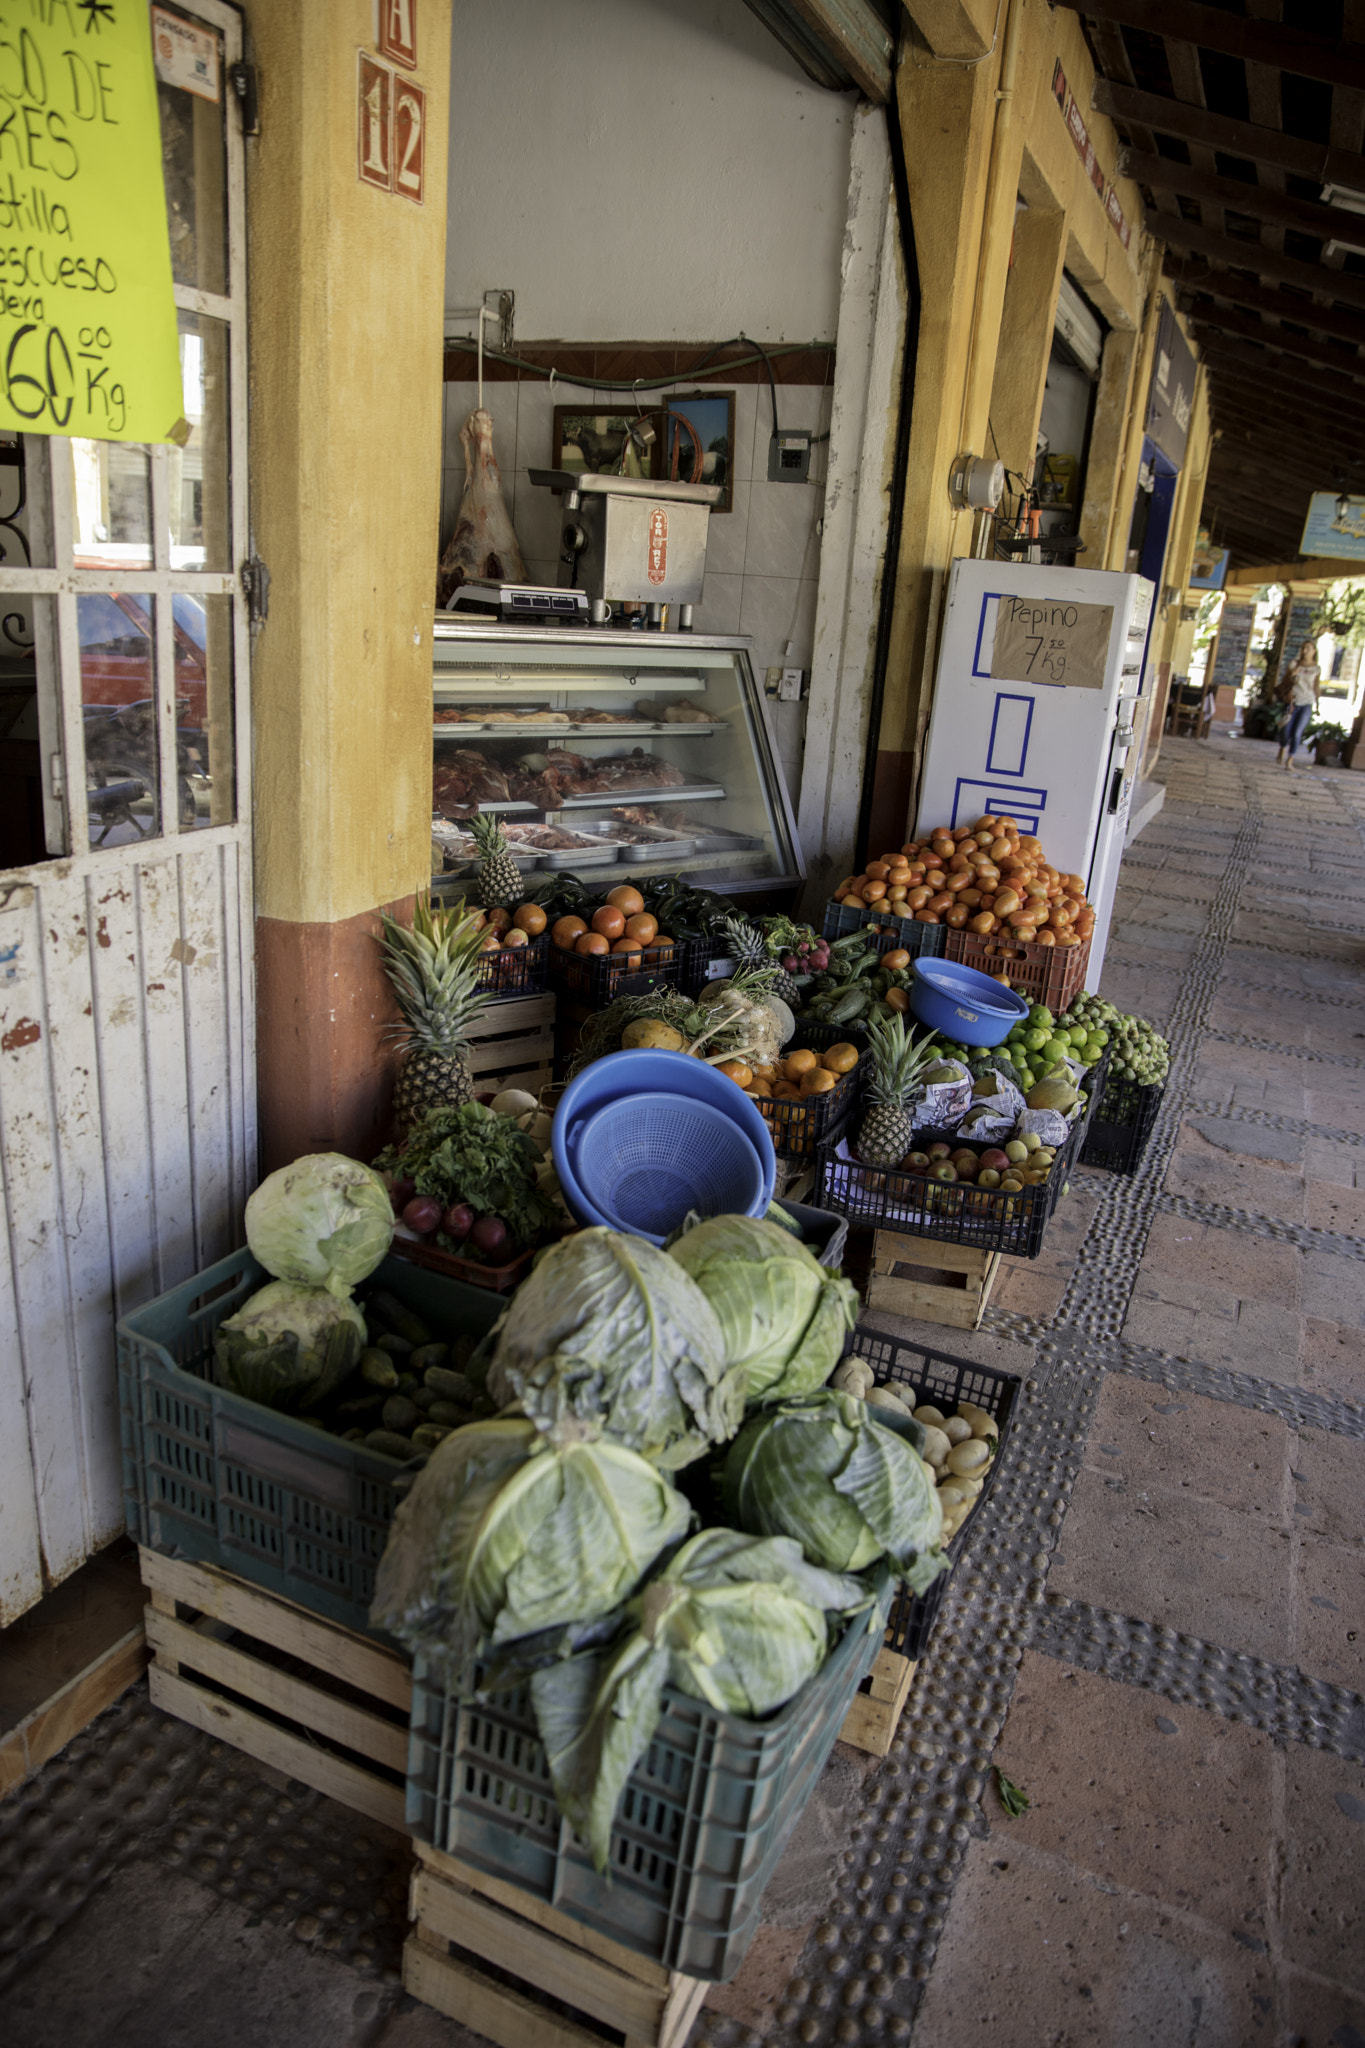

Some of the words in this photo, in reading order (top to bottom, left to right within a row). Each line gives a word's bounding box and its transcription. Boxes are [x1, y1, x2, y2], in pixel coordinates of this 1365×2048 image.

[62, 50, 119, 125] DE
[363, 75, 421, 190] 12
[652, 549, 661, 570] REY
[1007, 597, 1078, 635] Pepino
